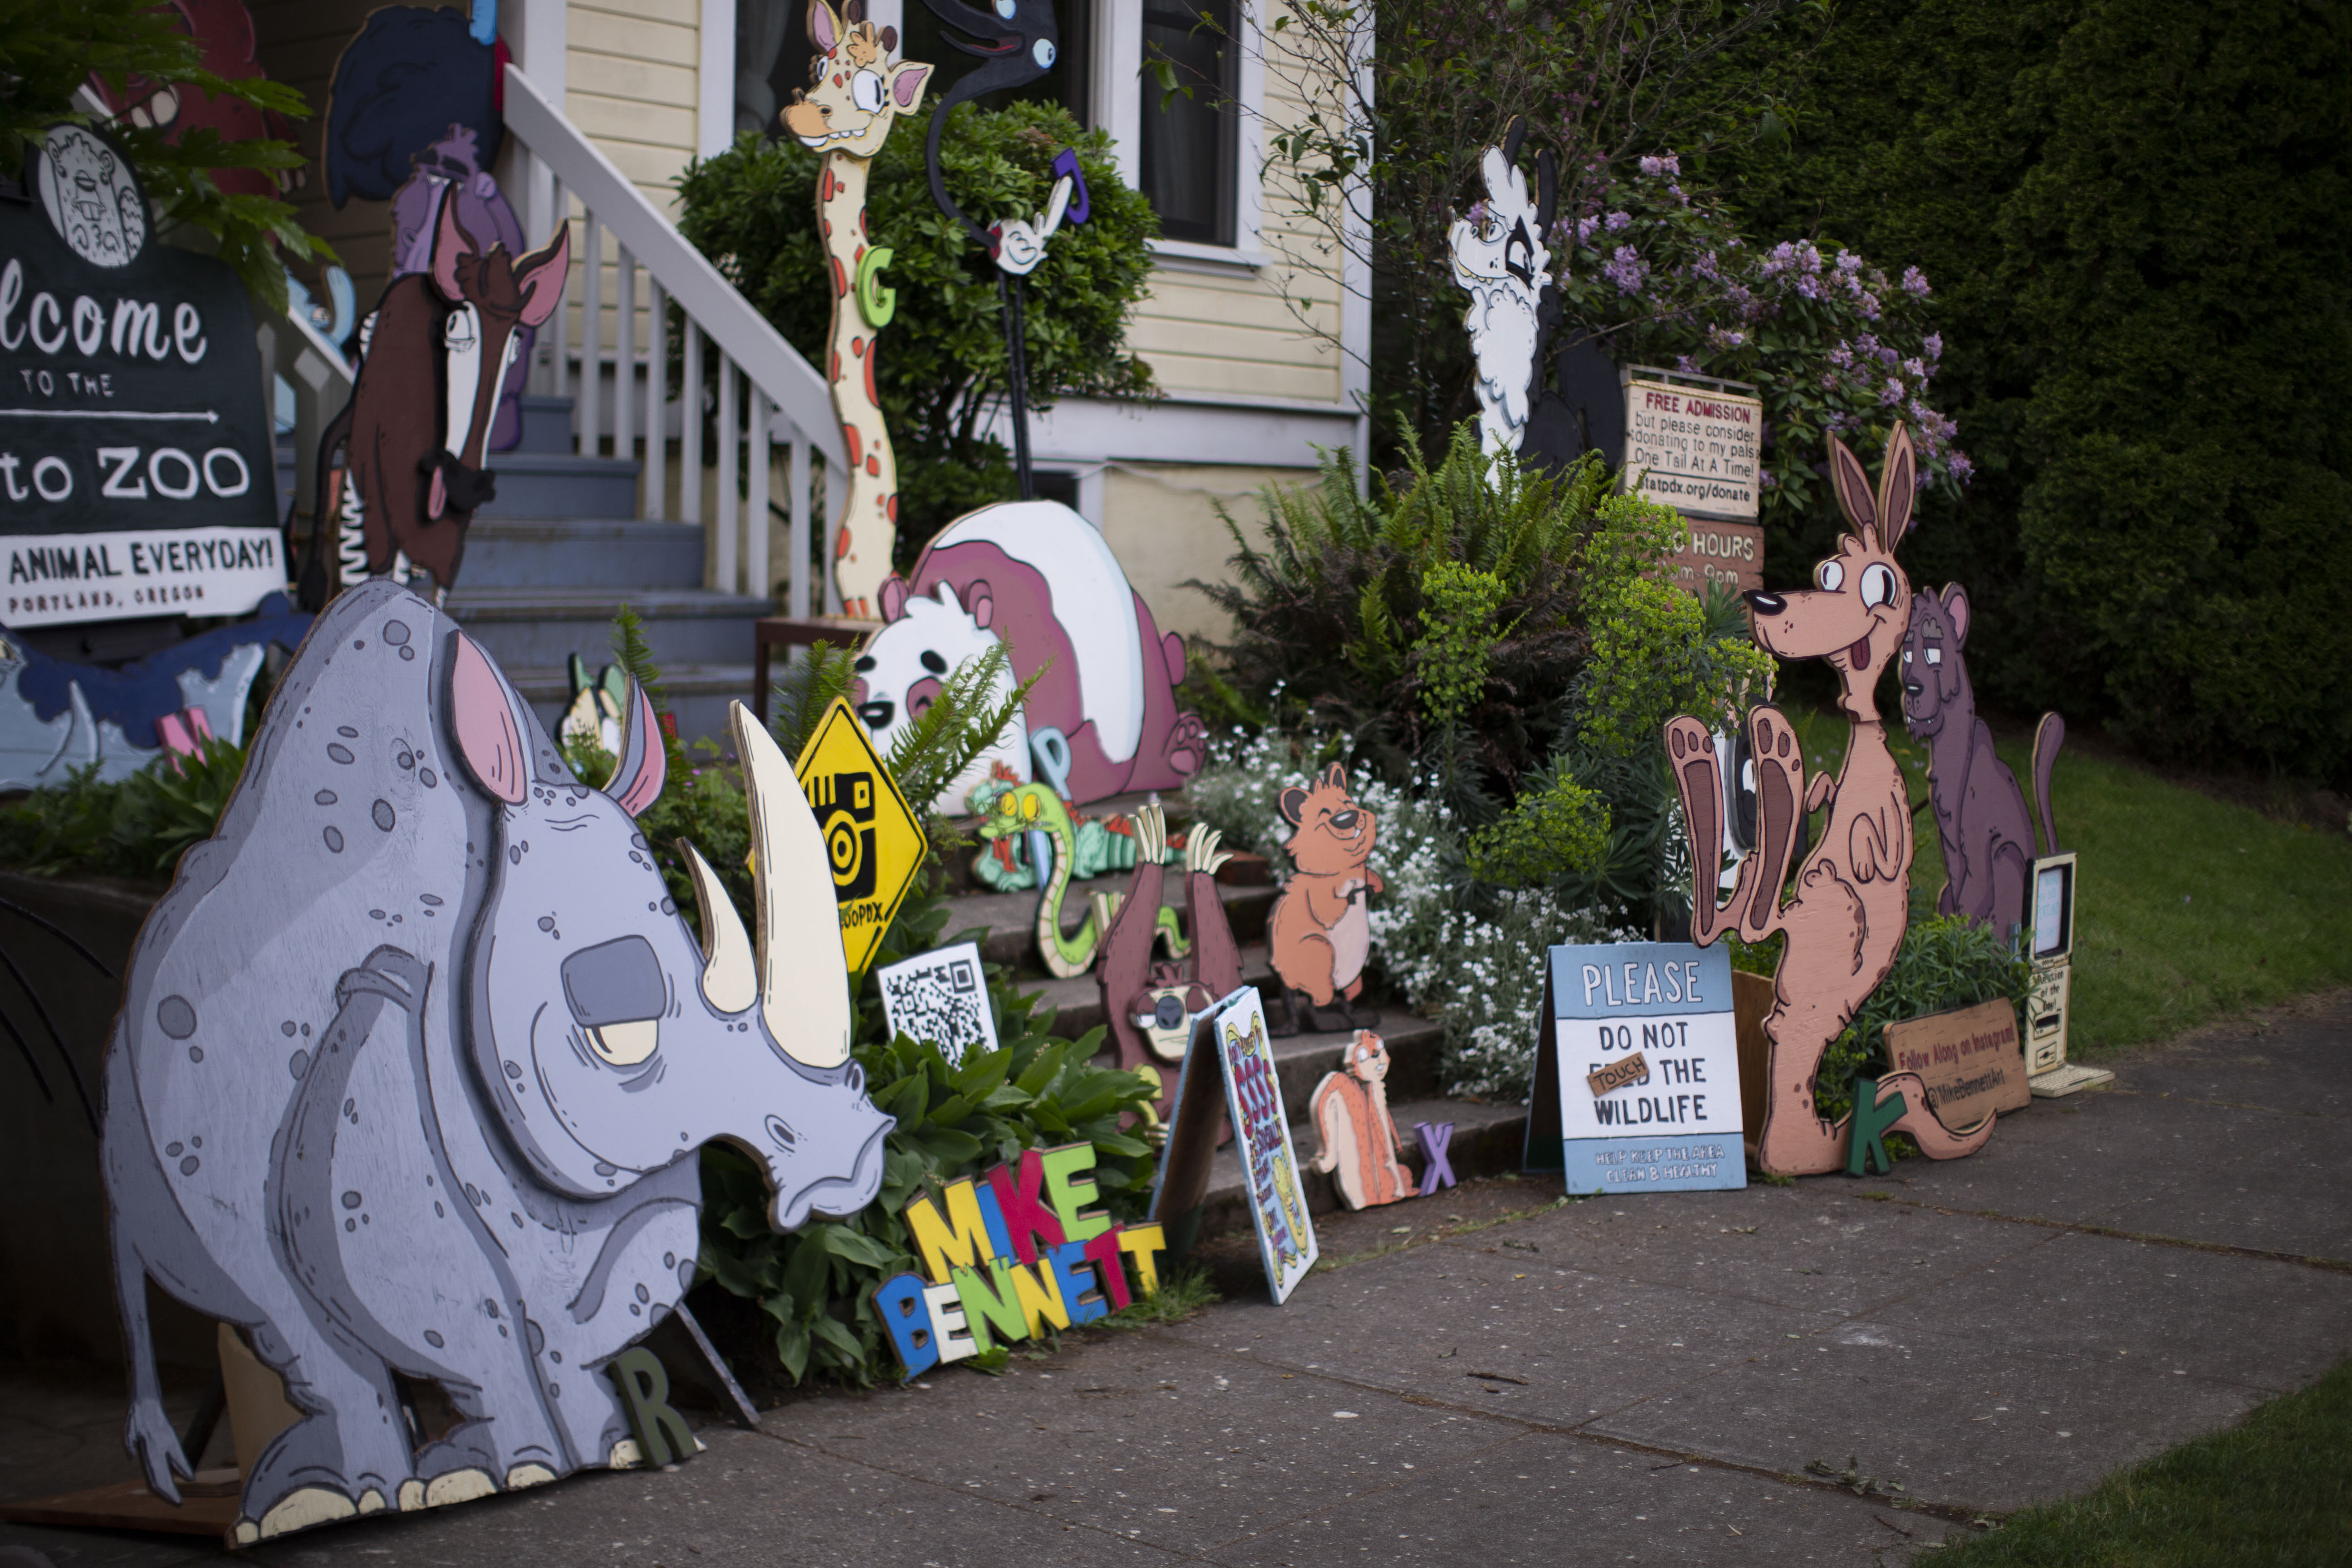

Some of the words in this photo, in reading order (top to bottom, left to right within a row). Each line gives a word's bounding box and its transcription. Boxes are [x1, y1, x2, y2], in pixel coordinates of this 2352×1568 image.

[857, 245, 896, 328] G
[19, 369, 54, 397] TO
[67, 372, 114, 397] THE
[1646, 392, 1680, 413] FREE
[1686, 399, 1750, 424] ADMISSION
[1636, 411, 1655, 429] but
[1661, 416, 1700, 435] please
[1706, 424, 1754, 442] consider
[1635, 447, 1659, 466] One
[1665, 451, 1686, 469] Tail
[1692, 456, 1705, 471] At
[1710, 457, 1717, 473] A
[1724, 459, 1754, 478] Time!
[1693, 439, 1705, 451] to
[1710, 441, 1725, 457] my
[97, 446, 250, 499] ZOO
[9, 544, 122, 584] ANIMAL
[130, 536, 273, 575] EVERYDAY!
[1692, 531, 1754, 562] HOURS
[9, 591, 123, 613] PORTLAND,
[134, 585, 205, 604] OREGON
[841, 902, 883, 928] OOPDX
[1583, 960, 1702, 1006] PLEASE
[2050, 984, 2060, 995] the
[1599, 1024, 1631, 1050] DO
[1642, 1022, 1688, 1049] NOT
[1899, 1049, 1929, 1071] Follow
[1933, 1042, 1959, 1065] Along
[1960, 1039, 1972, 1057] on
[1972, 1021, 2015, 1052] Instagram!
[1593, 1057, 1646, 1090] TOUCH
[1659, 1058, 1706, 1085] THE
[1594, 1095, 1707, 1125] WILDLIFE
[1846, 1078, 1907, 1177] K
[1413, 1122, 1457, 1197] X
[1595, 1151, 1627, 1165] HELP
[1631, 1148, 1662, 1163] KEEP
[1666, 1146, 1689, 1161] THE
[1692, 1144, 1725, 1159] AREA
[1606, 1166, 1645, 1183] CLEAN
[1648, 1166, 1660, 1181] &
[1664, 1162, 1717, 1179] HEALTHY
[905, 1142, 1112, 1284] MIKE
[872, 1221, 1166, 1384] BENNETT
[608, 1346, 698, 1470] R
